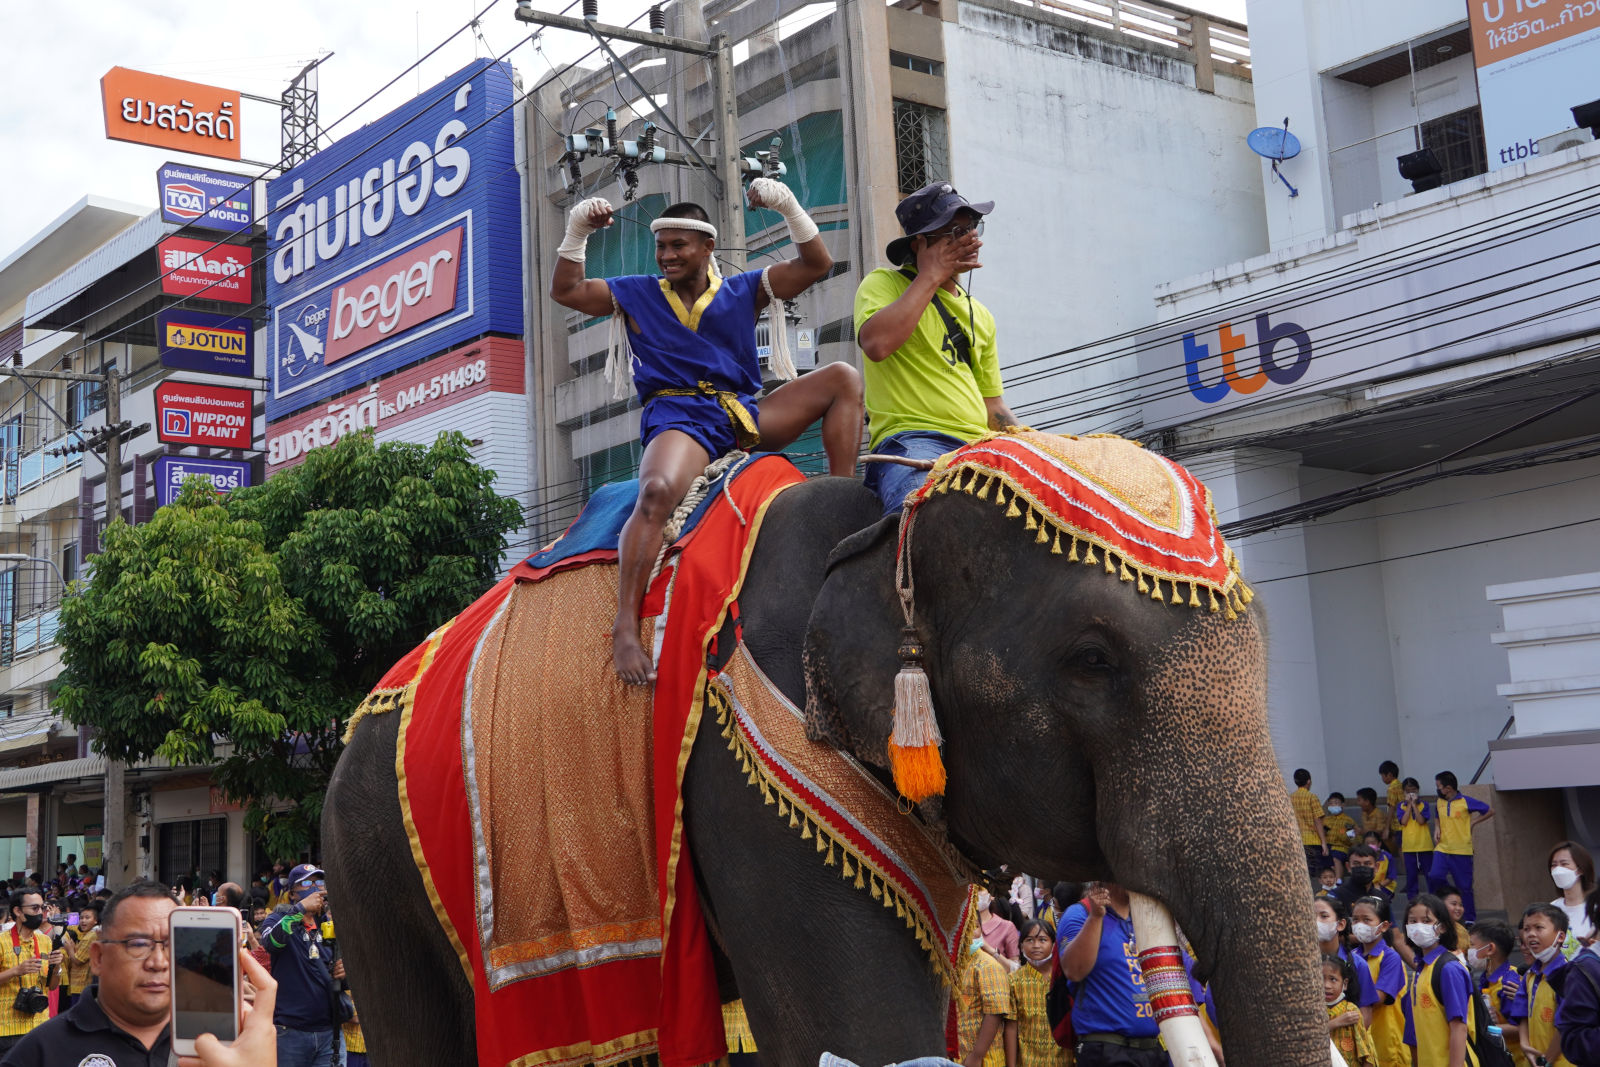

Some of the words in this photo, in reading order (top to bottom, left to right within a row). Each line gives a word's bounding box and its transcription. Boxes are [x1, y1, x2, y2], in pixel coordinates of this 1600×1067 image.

[122, 97, 235, 141] ยงสวัสดิ์
[273, 83, 472, 284] สีเบเยอร์
[167, 192, 203, 211] TOA
[208, 208, 249, 224] WORLD
[164, 249, 246, 278] สีเดลต้า
[333, 250, 453, 340] beger
[305, 307, 330, 327] beger
[188, 332, 243, 351] JOTUN
[1182, 312, 1313, 403] ttb
[396, 360, 487, 412] 044-511498
[193, 412, 246, 427] NIPPON
[197, 425, 240, 439] PAINT
